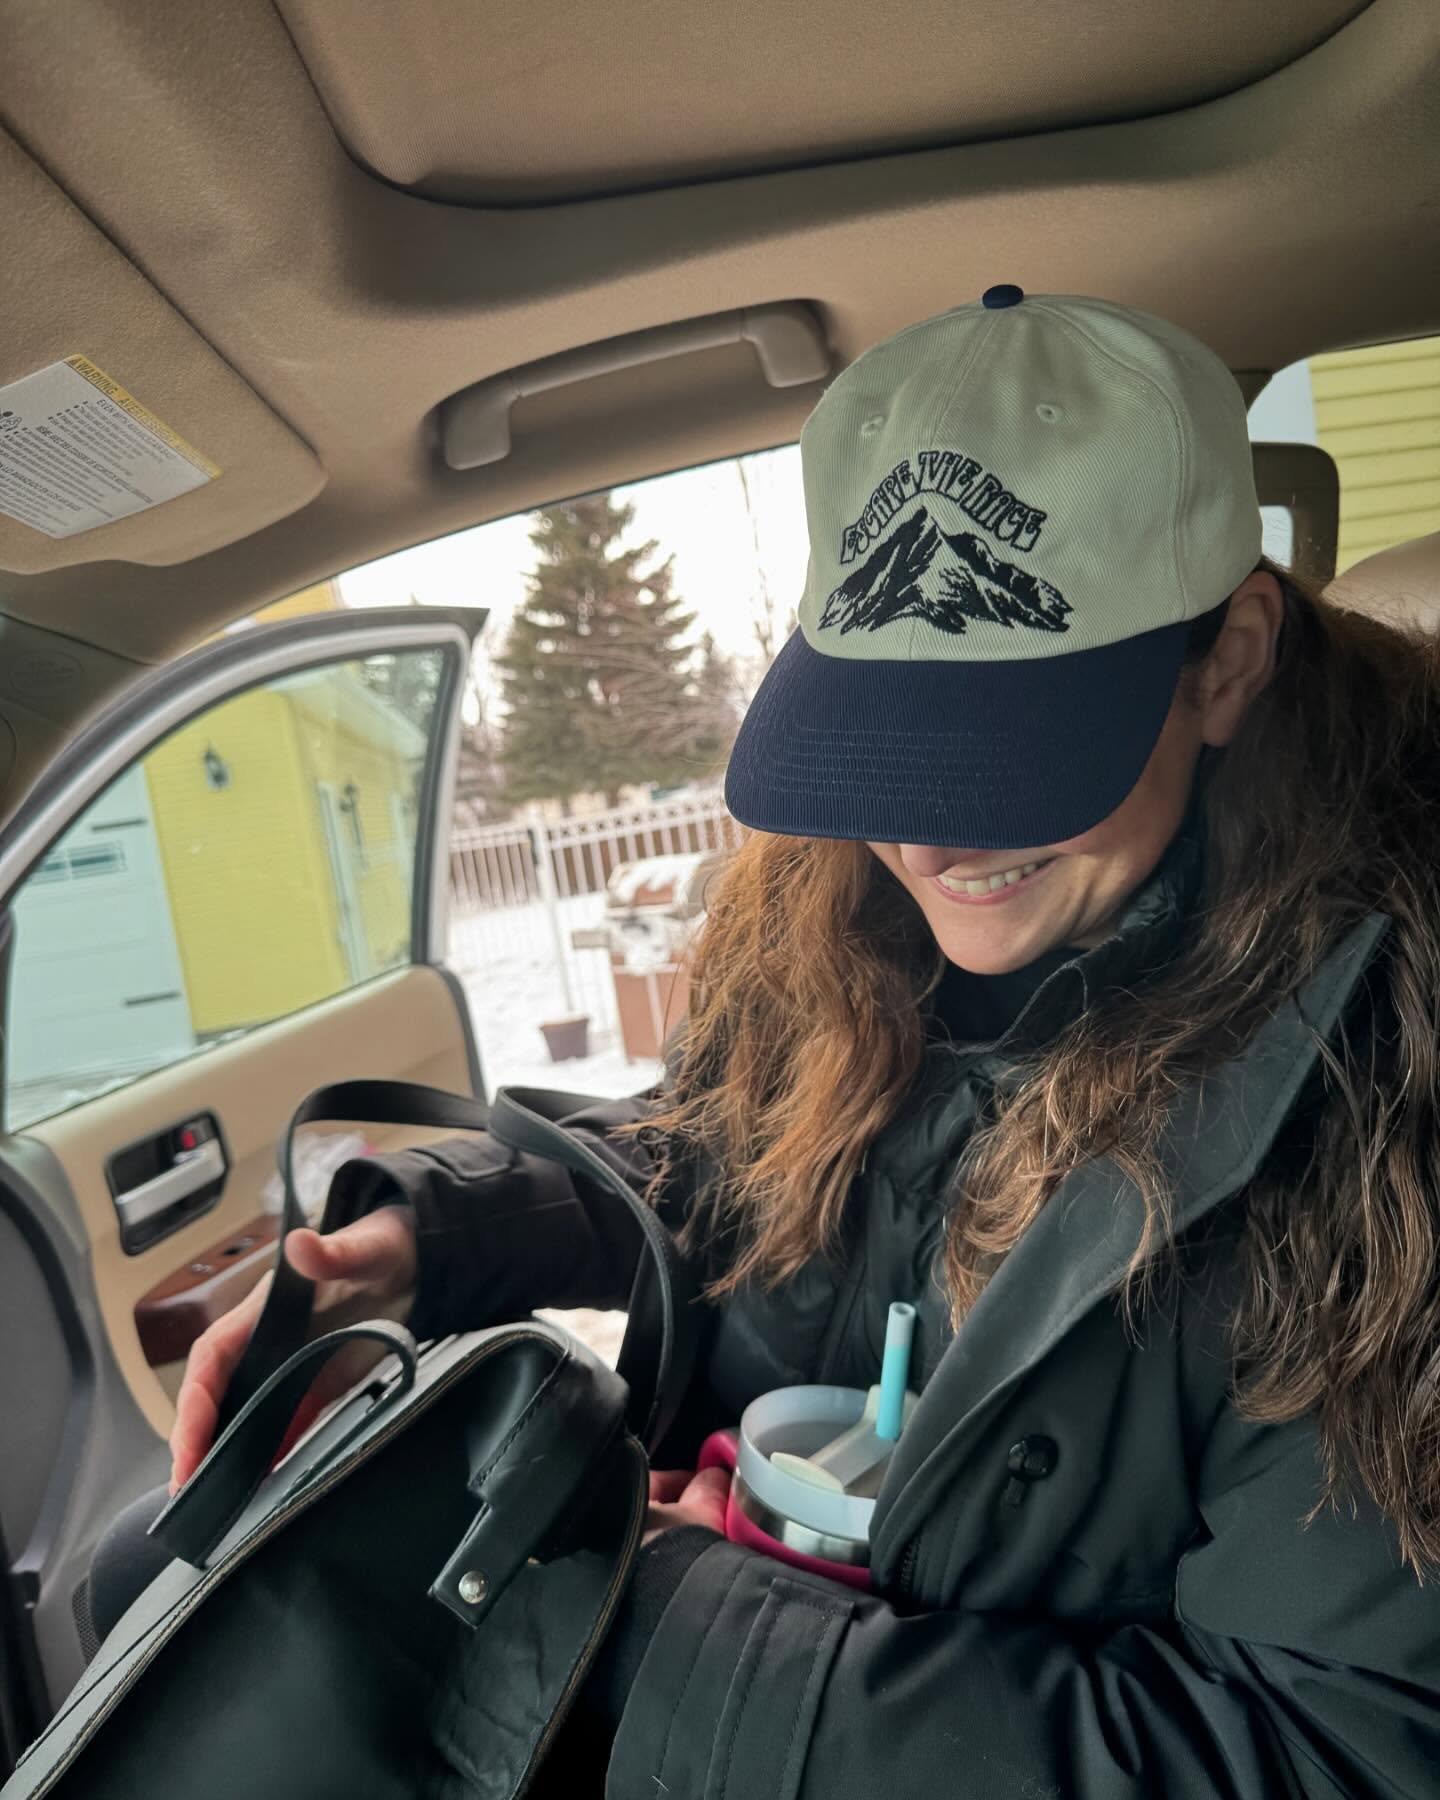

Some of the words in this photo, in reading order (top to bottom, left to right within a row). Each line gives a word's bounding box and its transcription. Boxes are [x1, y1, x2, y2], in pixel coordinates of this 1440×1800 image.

[76, 360, 118, 396] WARNING
[840, 460, 918, 564] ESCAPE
[918, 451, 983, 503] THE
[960, 474, 1047, 552] RACE
